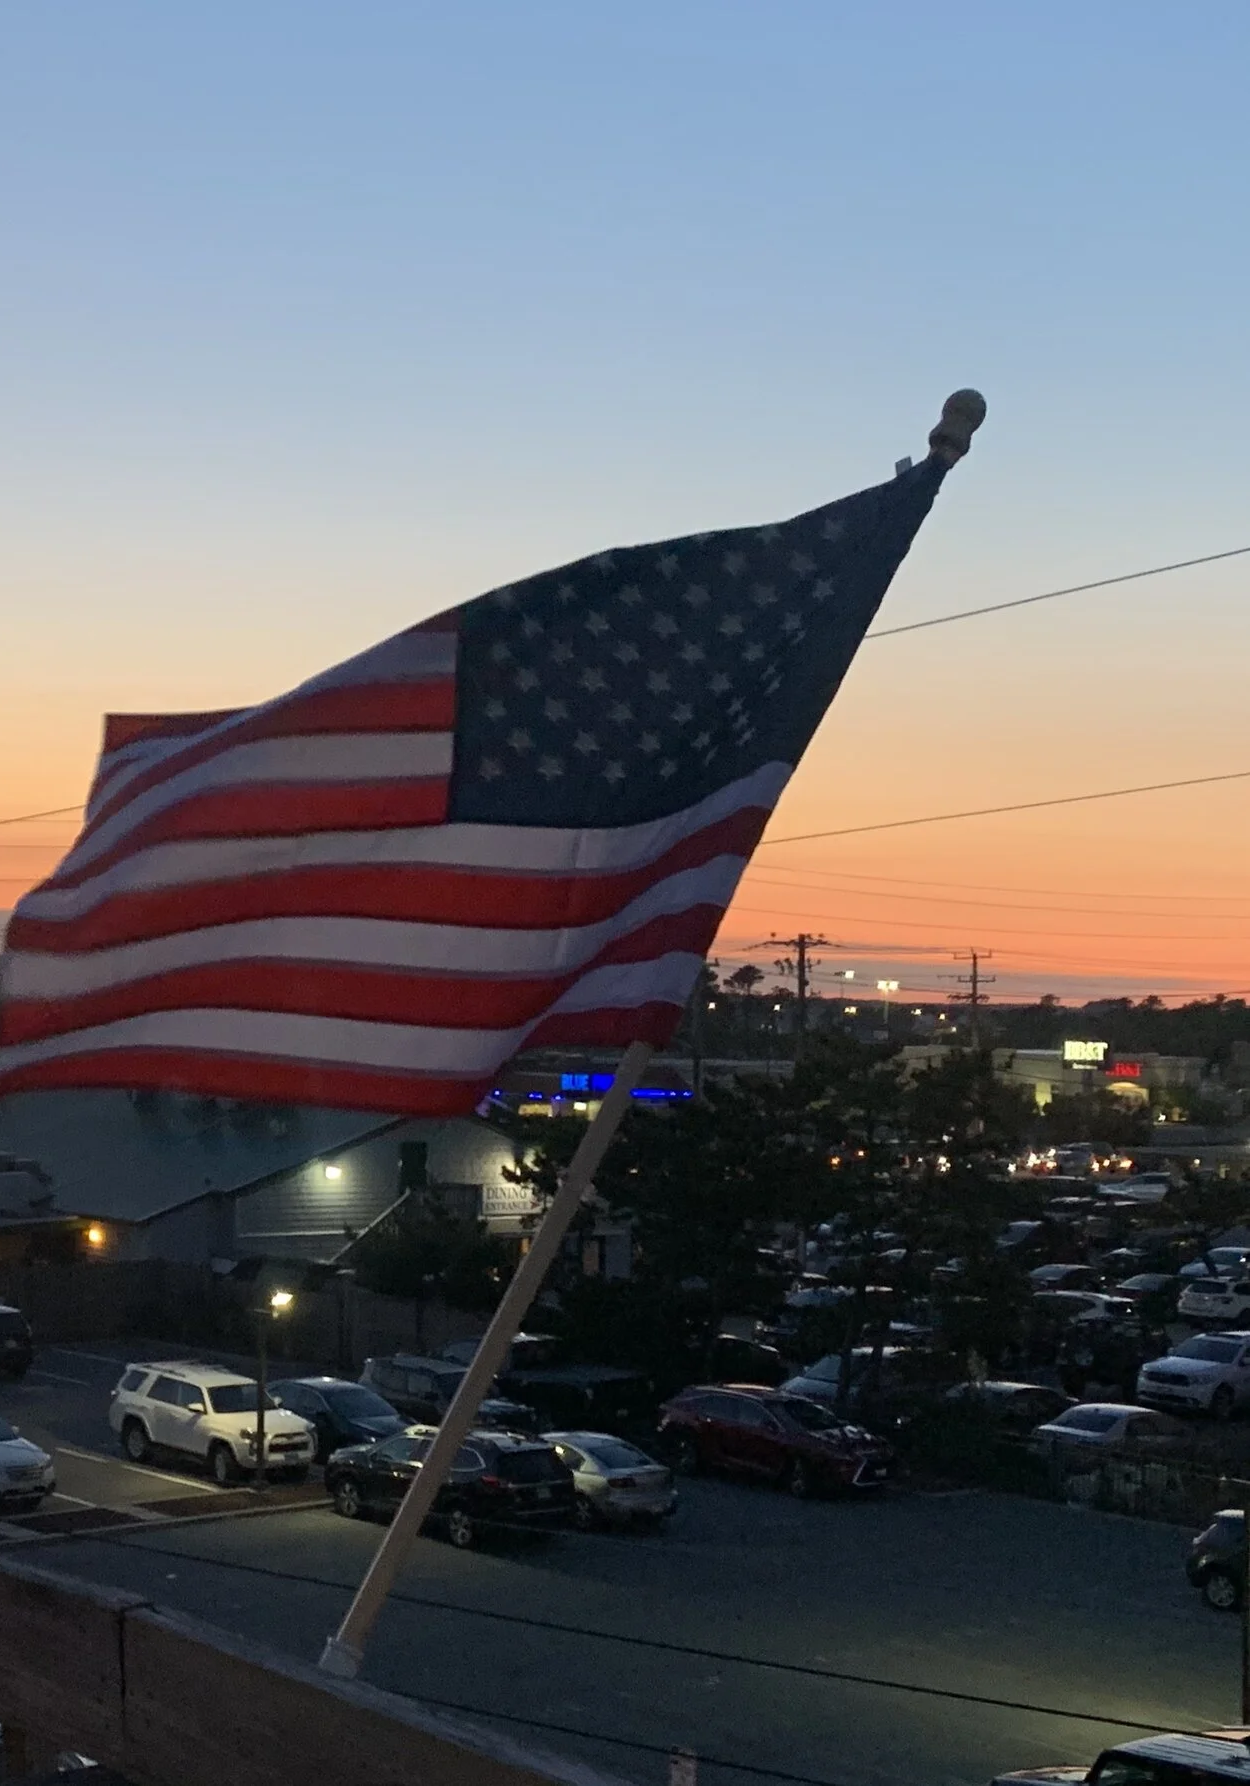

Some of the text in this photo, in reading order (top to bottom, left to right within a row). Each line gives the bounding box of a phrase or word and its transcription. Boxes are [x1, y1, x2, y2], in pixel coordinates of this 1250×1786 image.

[1064, 1041, 1108, 1061] BB&T
[561, 1073, 589, 1091] BLUE
[486, 1187, 528, 1199] DINING
